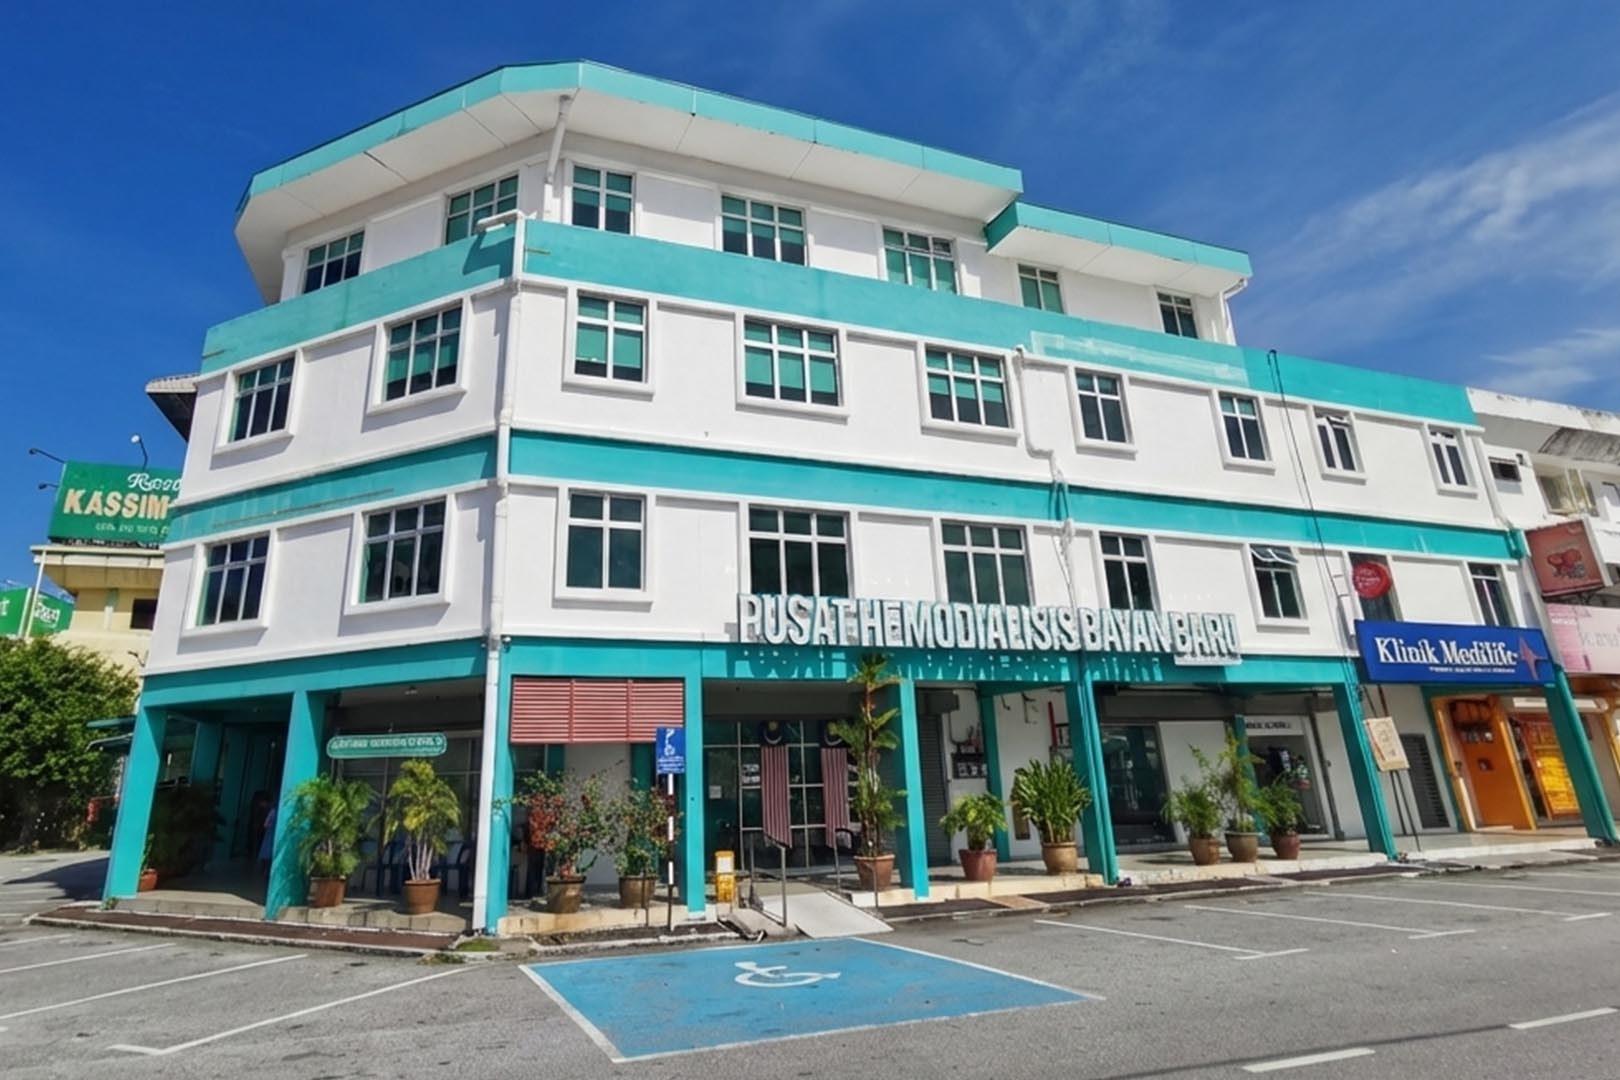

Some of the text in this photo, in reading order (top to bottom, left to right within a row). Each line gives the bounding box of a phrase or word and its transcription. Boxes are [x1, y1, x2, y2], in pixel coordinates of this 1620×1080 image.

[63, 488, 171, 520] KASSIM
[738, 593, 853, 646] PUSAT
[1080, 607, 1173, 653] BAYAN
[1169, 611, 1240, 657] BARU
[1375, 637, 1439, 664] Klinik
